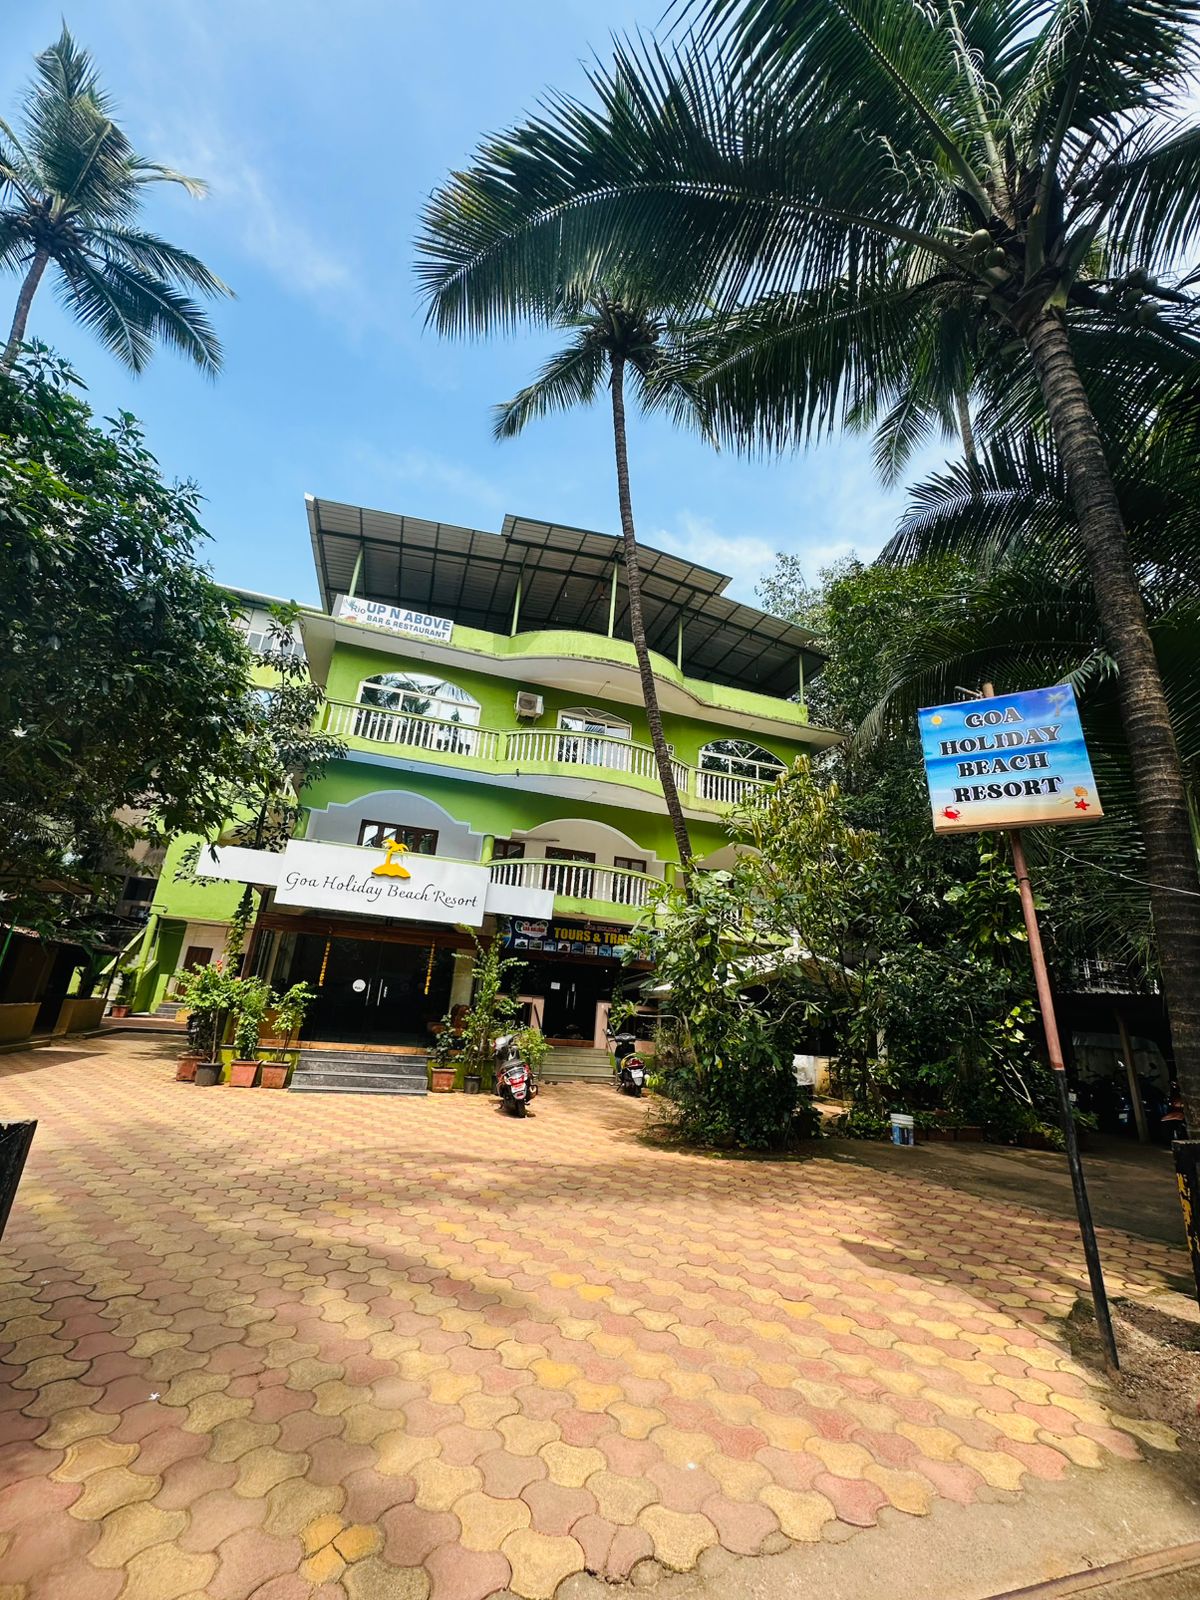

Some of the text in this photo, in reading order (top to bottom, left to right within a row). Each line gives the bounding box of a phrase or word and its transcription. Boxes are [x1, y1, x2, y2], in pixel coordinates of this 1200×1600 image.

[366, 602, 451, 632] UP N ABOVE
[366, 614, 447, 639] BAR & RESTAURANT
[965, 708, 1022, 729] GOA
[939, 724, 1062, 757] HOLIDAY
[957, 752, 1050, 778] BEACH
[953, 776, 1062, 803] RESORT
[285, 871, 478, 909] Goa Holiday Beach Resort
[554, 927, 591, 942] TOURS
[593, 933, 601, 943] &
